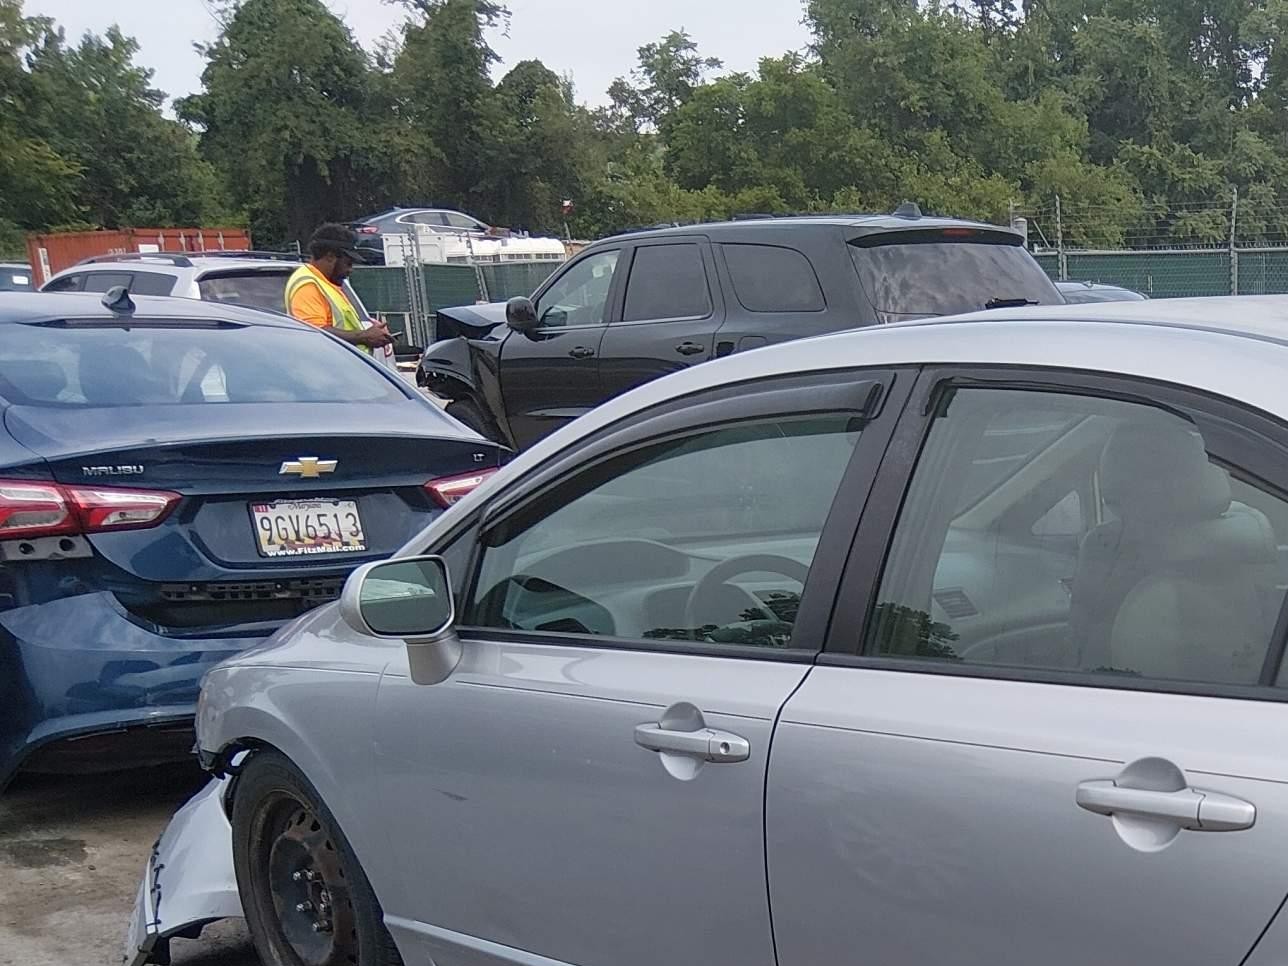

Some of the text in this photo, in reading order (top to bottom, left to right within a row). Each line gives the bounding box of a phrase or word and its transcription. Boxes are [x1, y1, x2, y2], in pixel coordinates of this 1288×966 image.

[473, 453, 485, 462] LT
[82, 465, 144, 476] MALIBU
[260, 512, 361, 545] 9GV6513
